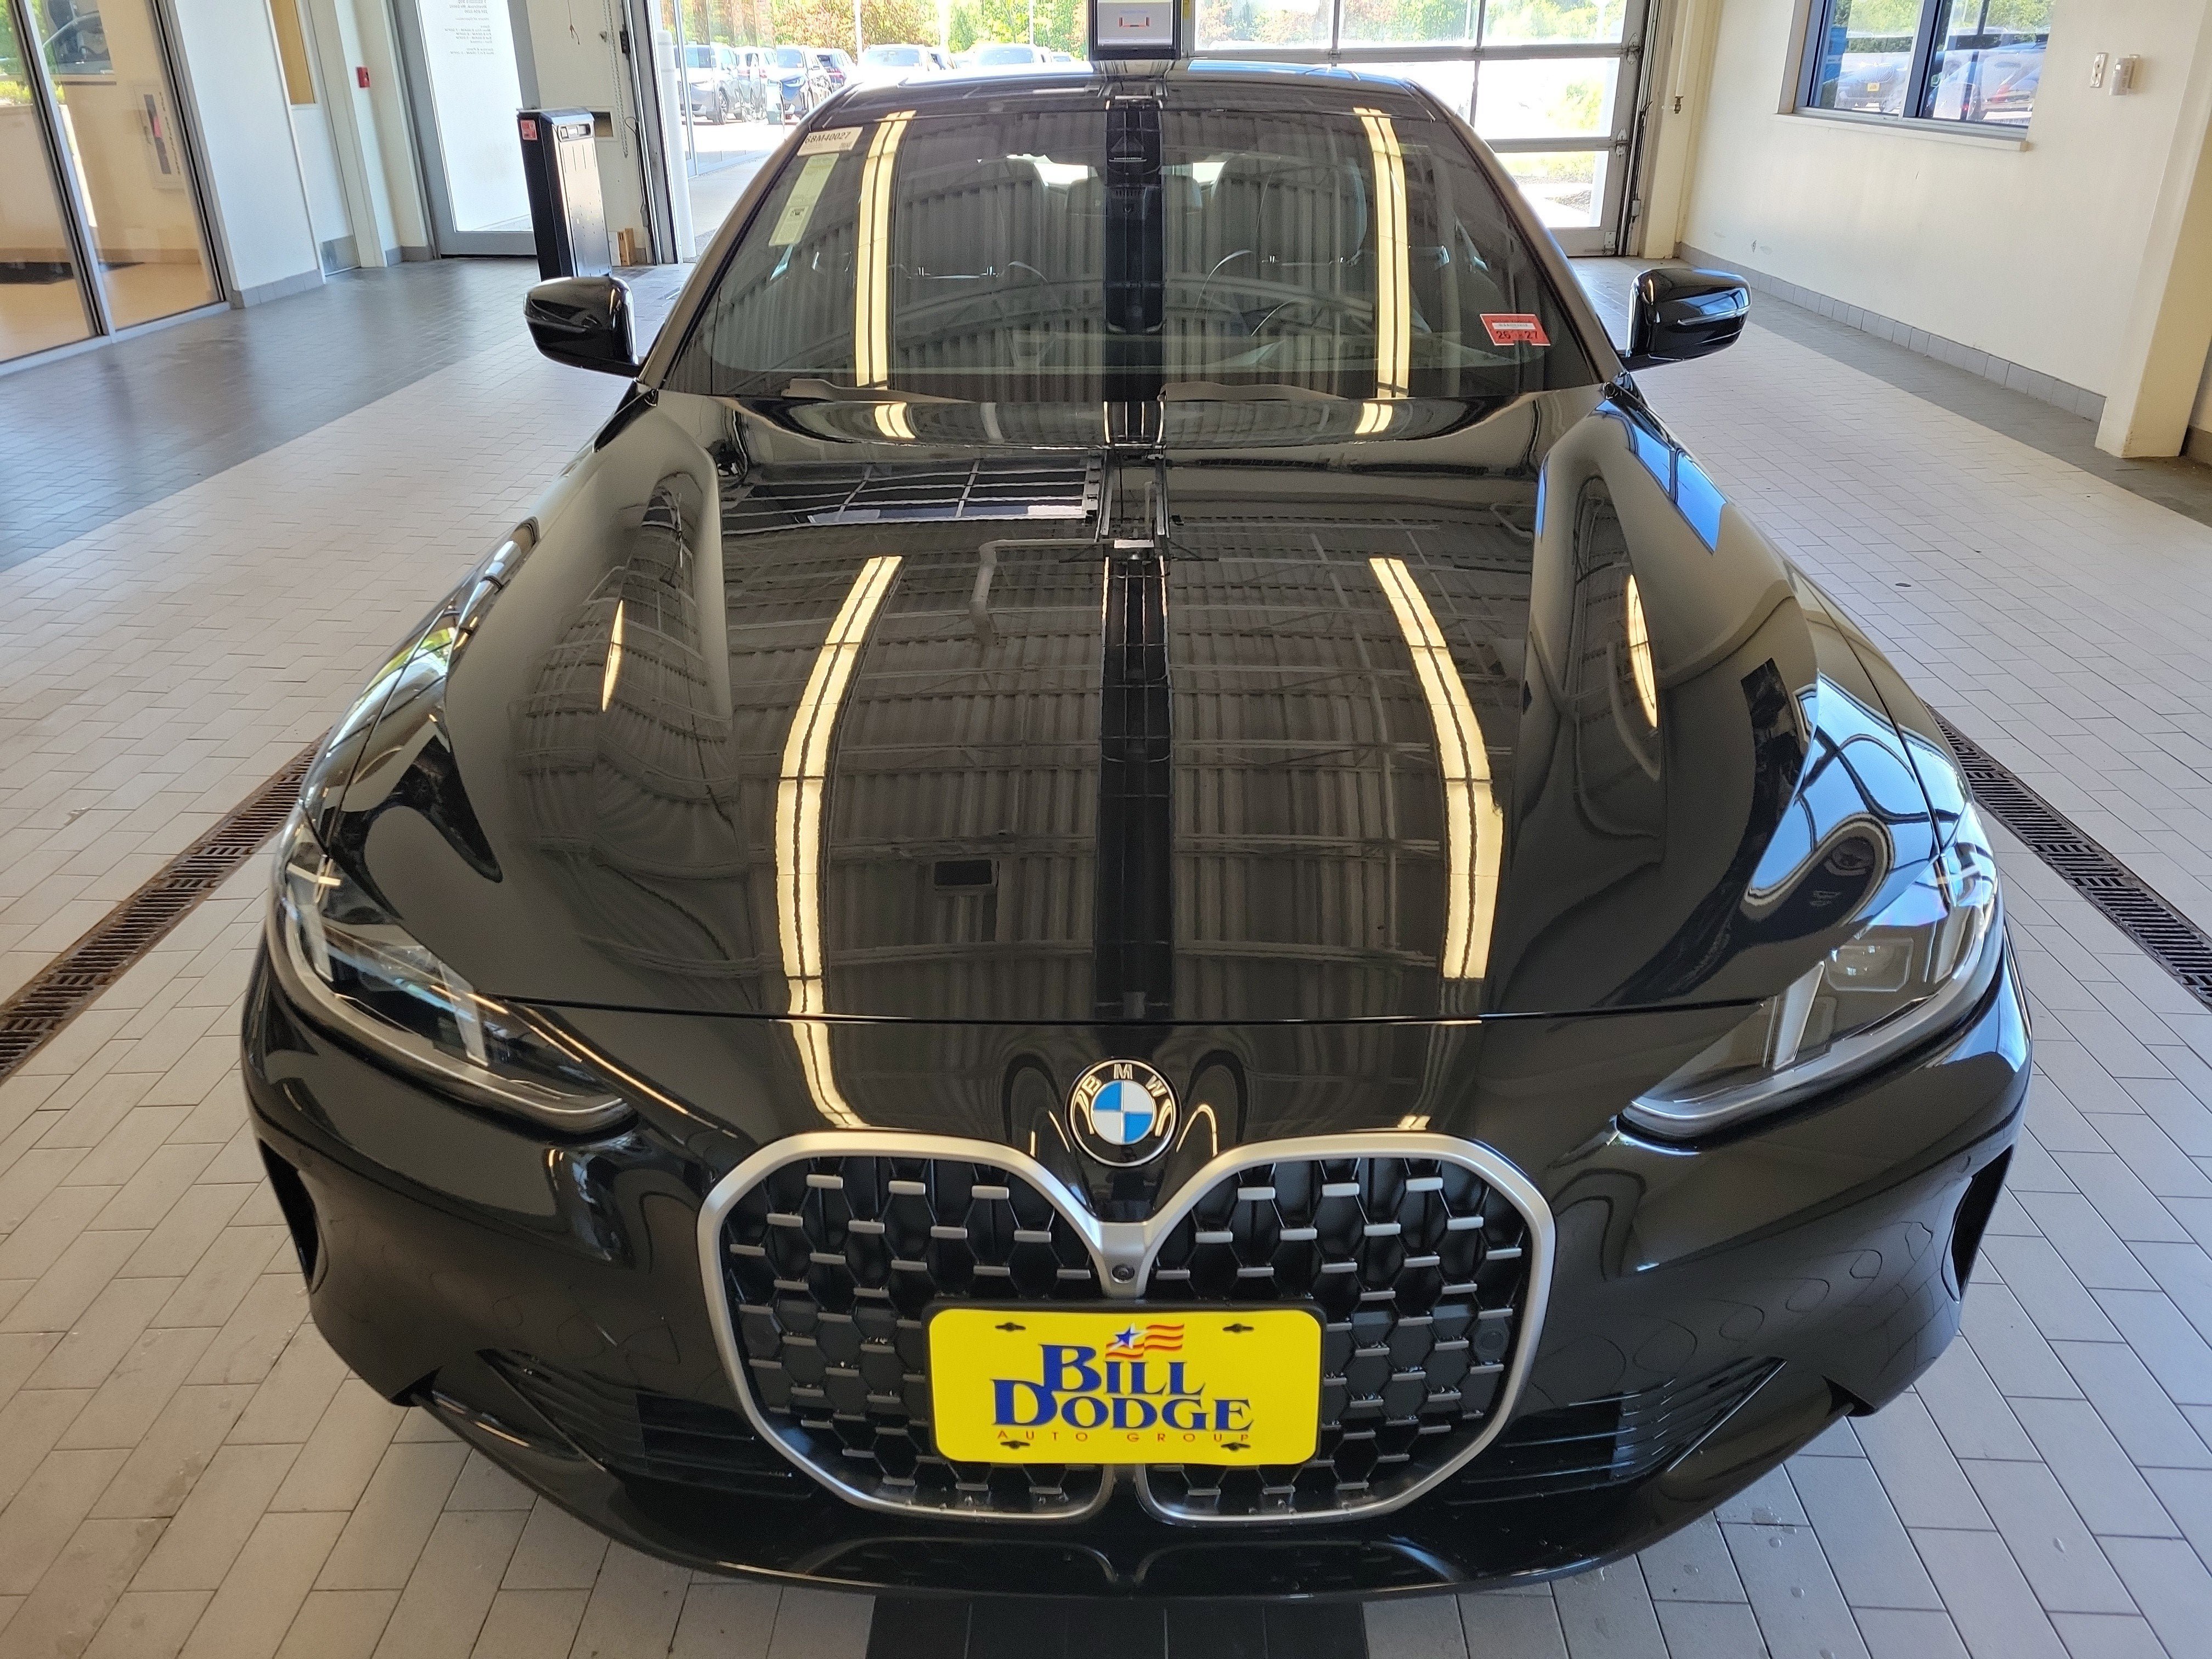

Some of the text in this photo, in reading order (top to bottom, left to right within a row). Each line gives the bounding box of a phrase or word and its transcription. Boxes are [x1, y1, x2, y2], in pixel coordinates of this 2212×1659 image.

[1080, 1063, 1167, 1097] BMW
[1037, 1344, 1205, 1396] BILL
[990, 1378, 1254, 1432] DODGE
[997, 1430, 1250, 1443] AUTO GROUP
